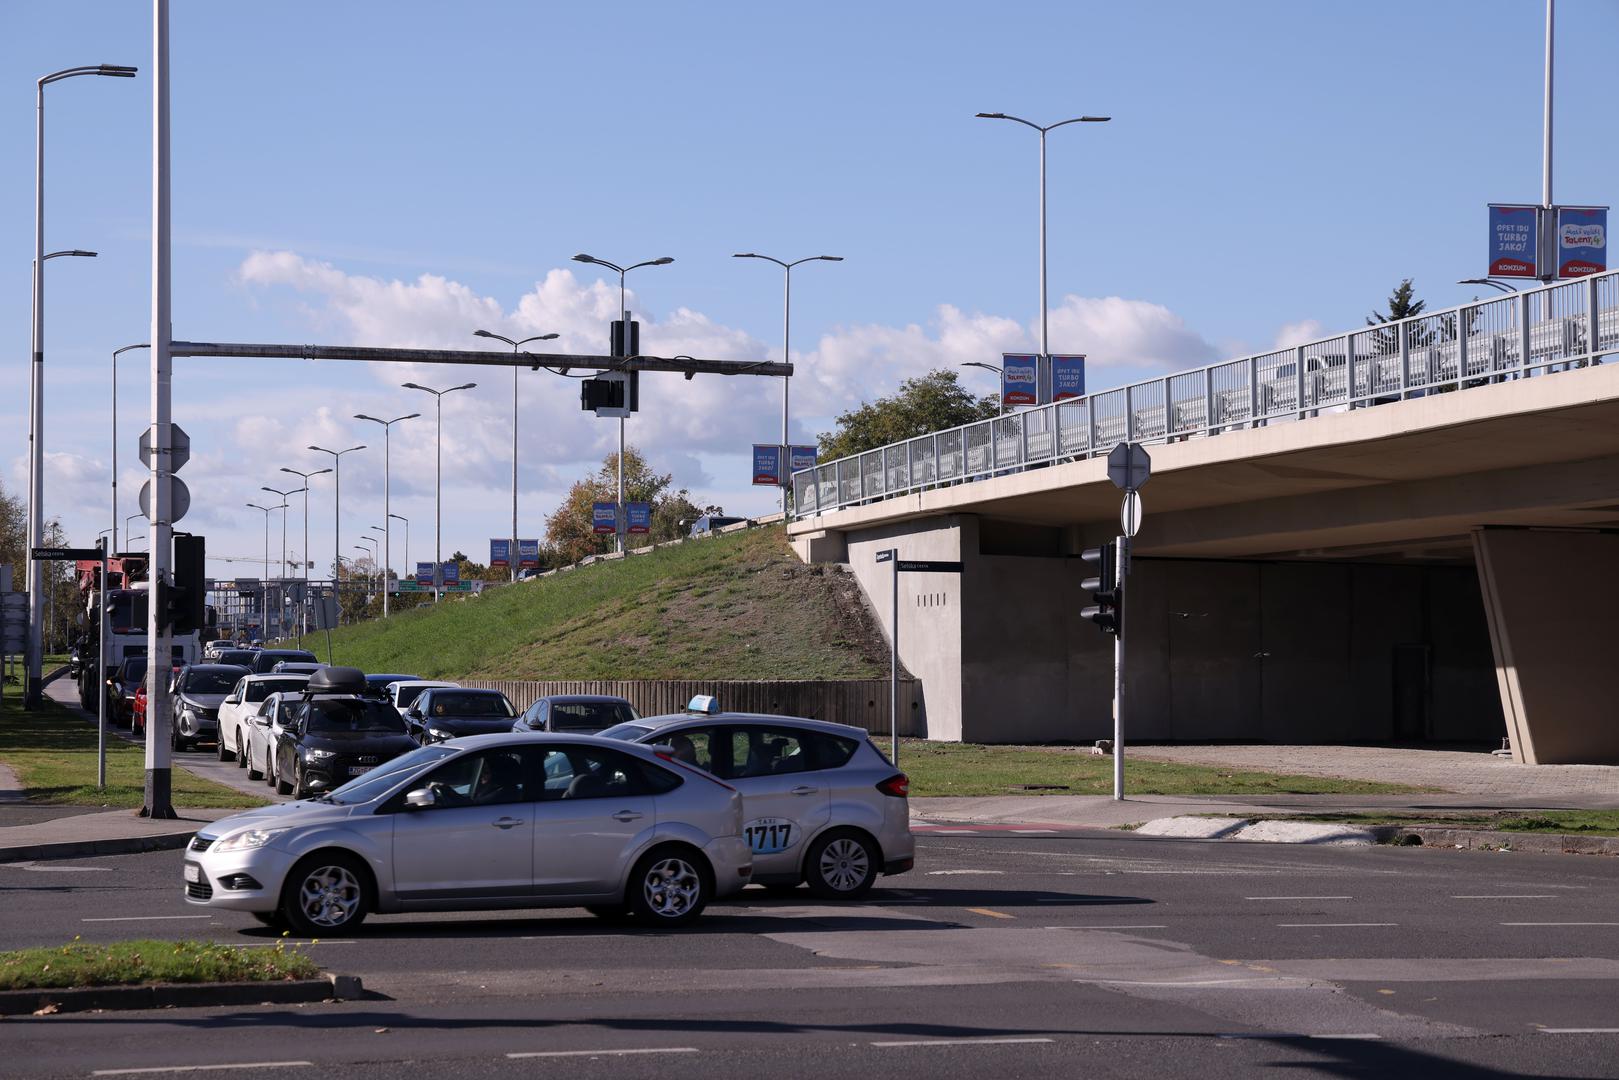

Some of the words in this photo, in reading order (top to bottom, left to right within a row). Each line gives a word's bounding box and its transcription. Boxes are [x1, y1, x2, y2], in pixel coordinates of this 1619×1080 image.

[1497, 224, 1514, 232] OPET
[1516, 224, 1529, 232] IDU
[1498, 233, 1528, 241] TURBO
[1498, 242, 1527, 252] JAKO!
[1498, 264, 1527, 272] KONZUM
[745, 824, 792, 849] 1717
